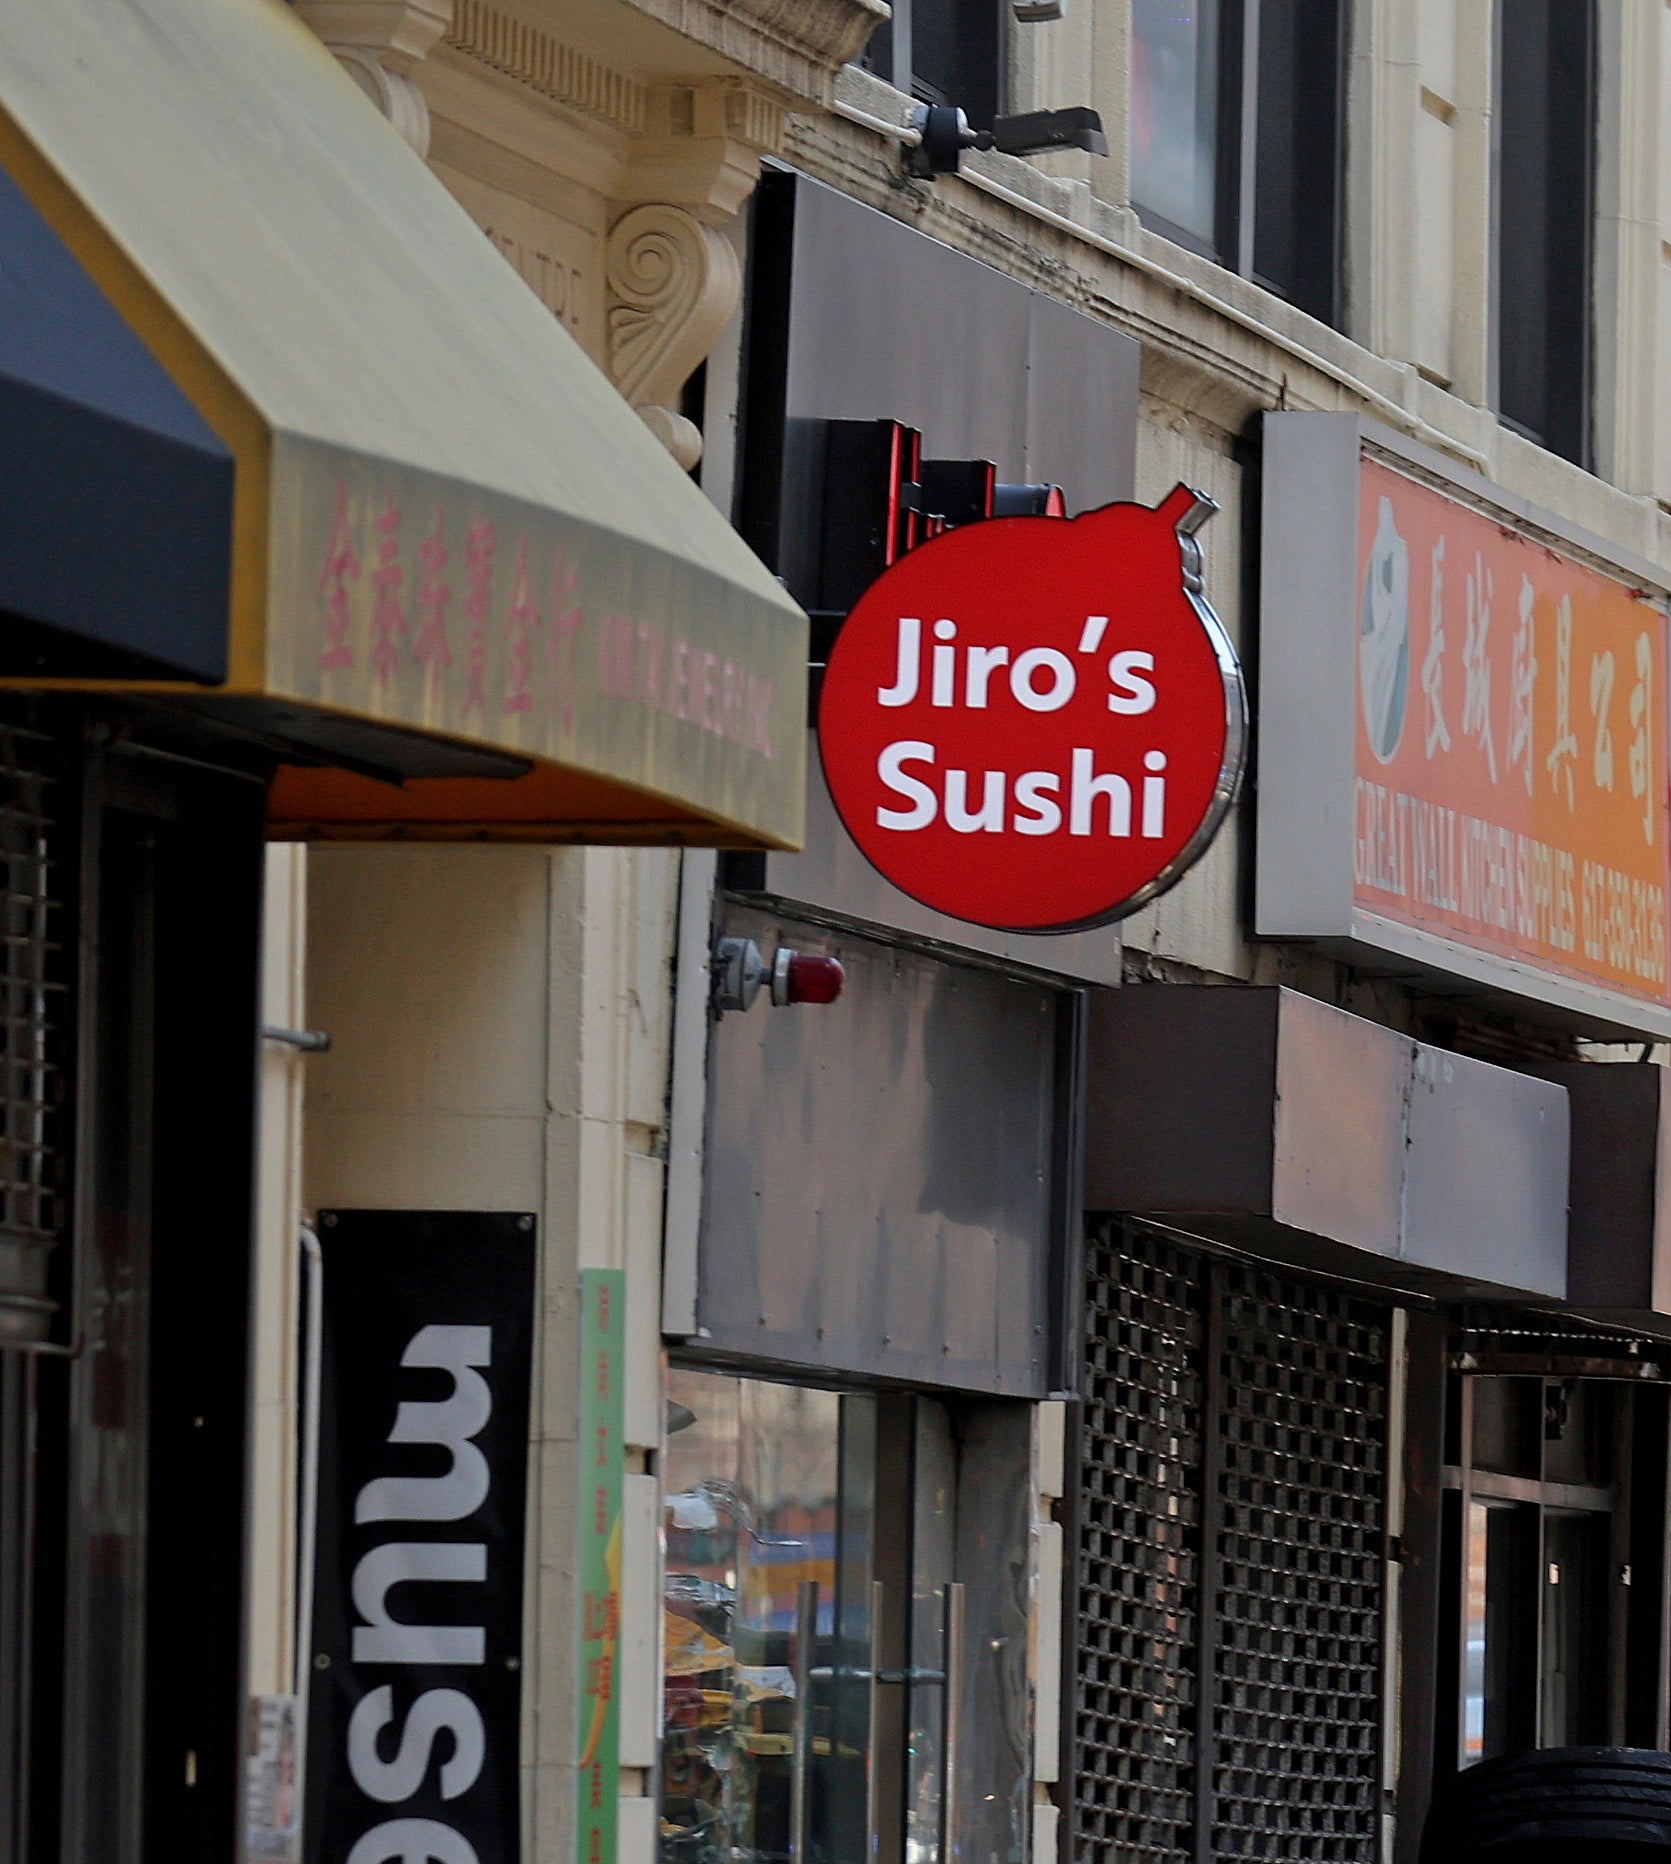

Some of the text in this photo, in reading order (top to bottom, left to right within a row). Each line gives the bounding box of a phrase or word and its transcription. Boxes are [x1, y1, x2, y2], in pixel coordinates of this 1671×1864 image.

[877, 615, 1157, 717] Jiro's
[876, 740, 1169, 840] Sushi
[1353, 775, 1408, 898] GREAT
[1409, 795, 1459, 913] WALL
